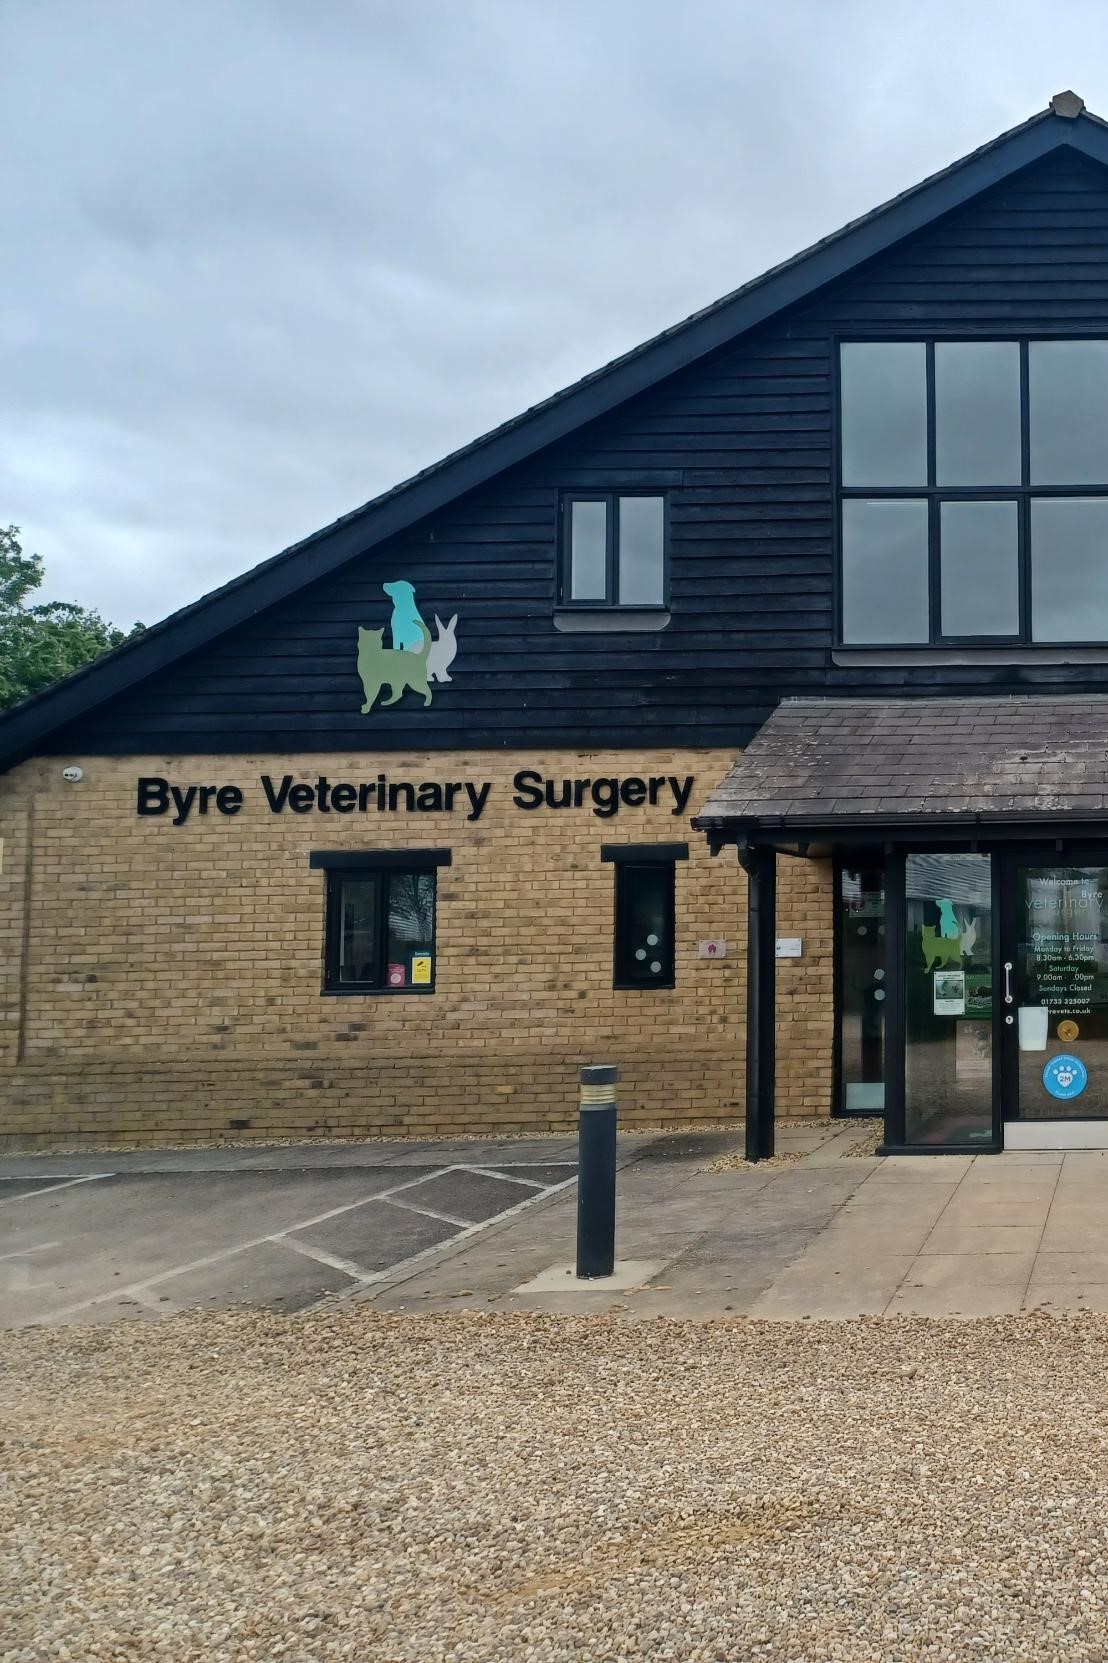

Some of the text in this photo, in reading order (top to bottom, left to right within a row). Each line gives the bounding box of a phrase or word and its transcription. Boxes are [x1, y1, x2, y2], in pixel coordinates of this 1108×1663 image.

[137, 770, 694, 826] Byre Veterinary Surgery
[1039, 875, 1091, 886] Welcome to
[1081, 889, 1103, 901] Byre
[1025, 897, 1104, 913] veterinary
[1032, 931, 1098, 943] Opening Hours
[1034, 945, 1062, 954] Monday
[1072, 944, 1095, 954] Friday
[1049, 964, 1080, 974] Saturday
[1039, 983, 1092, 993] Sundays Closed
[1041, 1007, 1091, 1016] revets.co.uk
